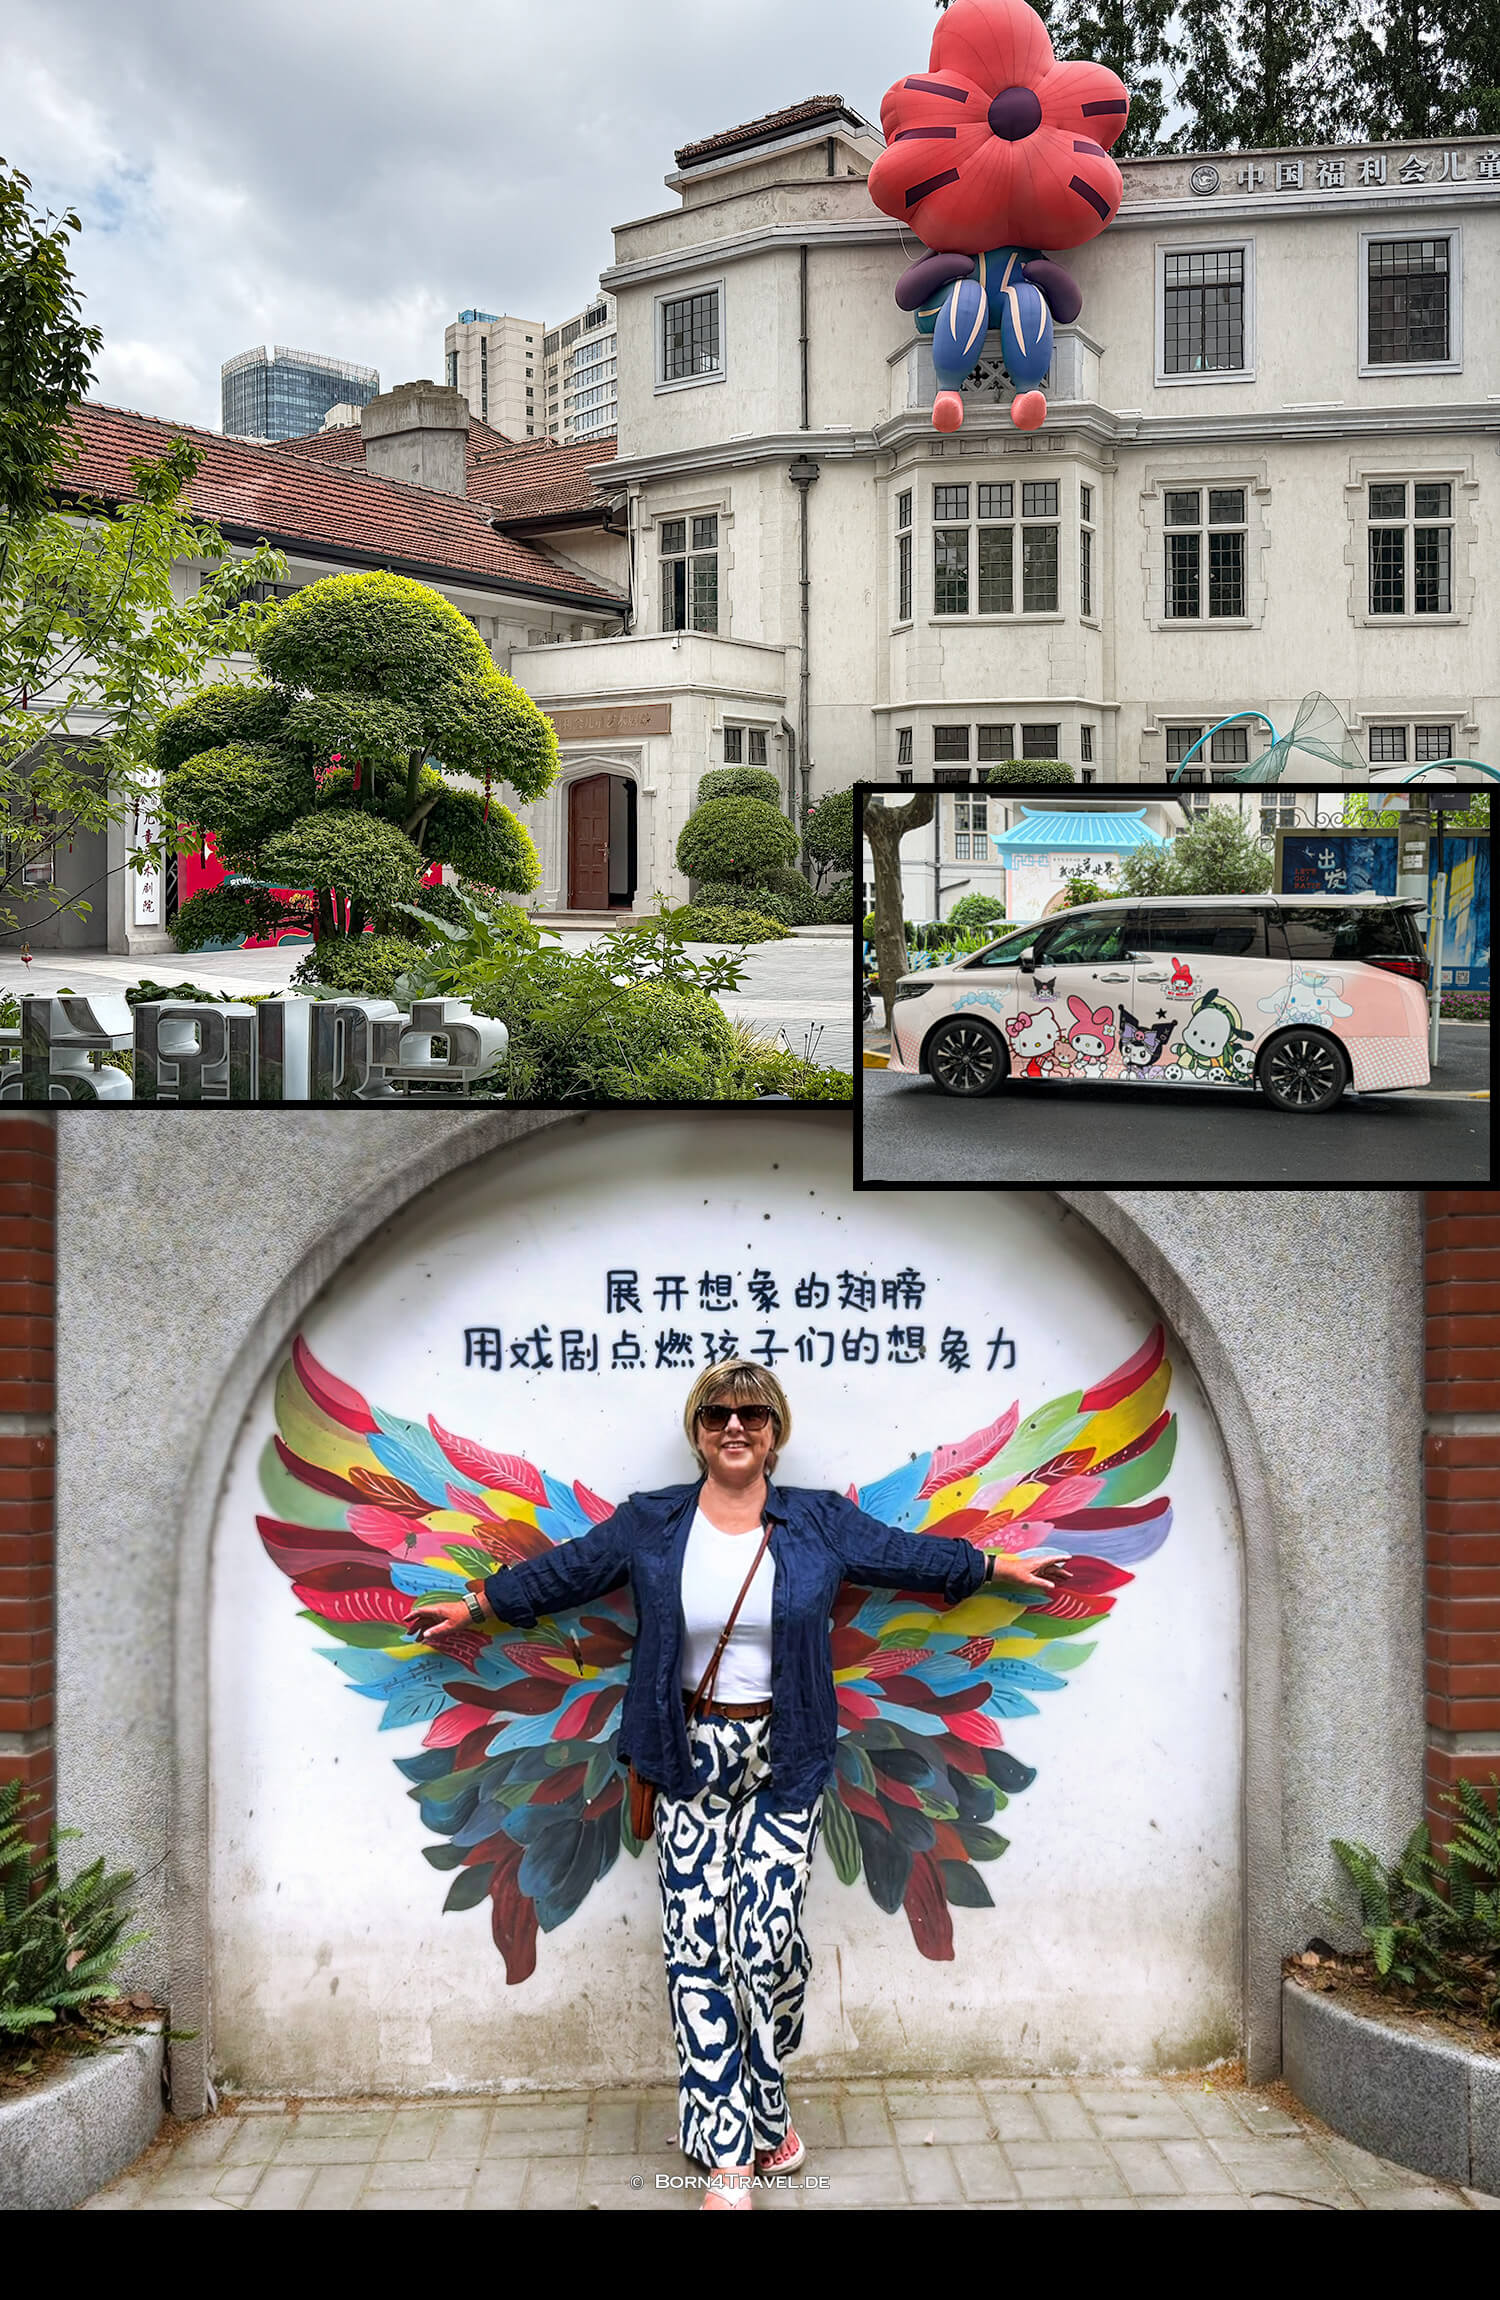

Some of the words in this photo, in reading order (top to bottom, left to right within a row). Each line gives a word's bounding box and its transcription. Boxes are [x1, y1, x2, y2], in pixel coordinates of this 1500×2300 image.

[1237, 149, 1500, 194] 中国福利会儿童
[606, 1268, 926, 1313] 展开想象的翅膀
[464, 1325, 1017, 1373] 用戏剧点燃孩子们的想象力
